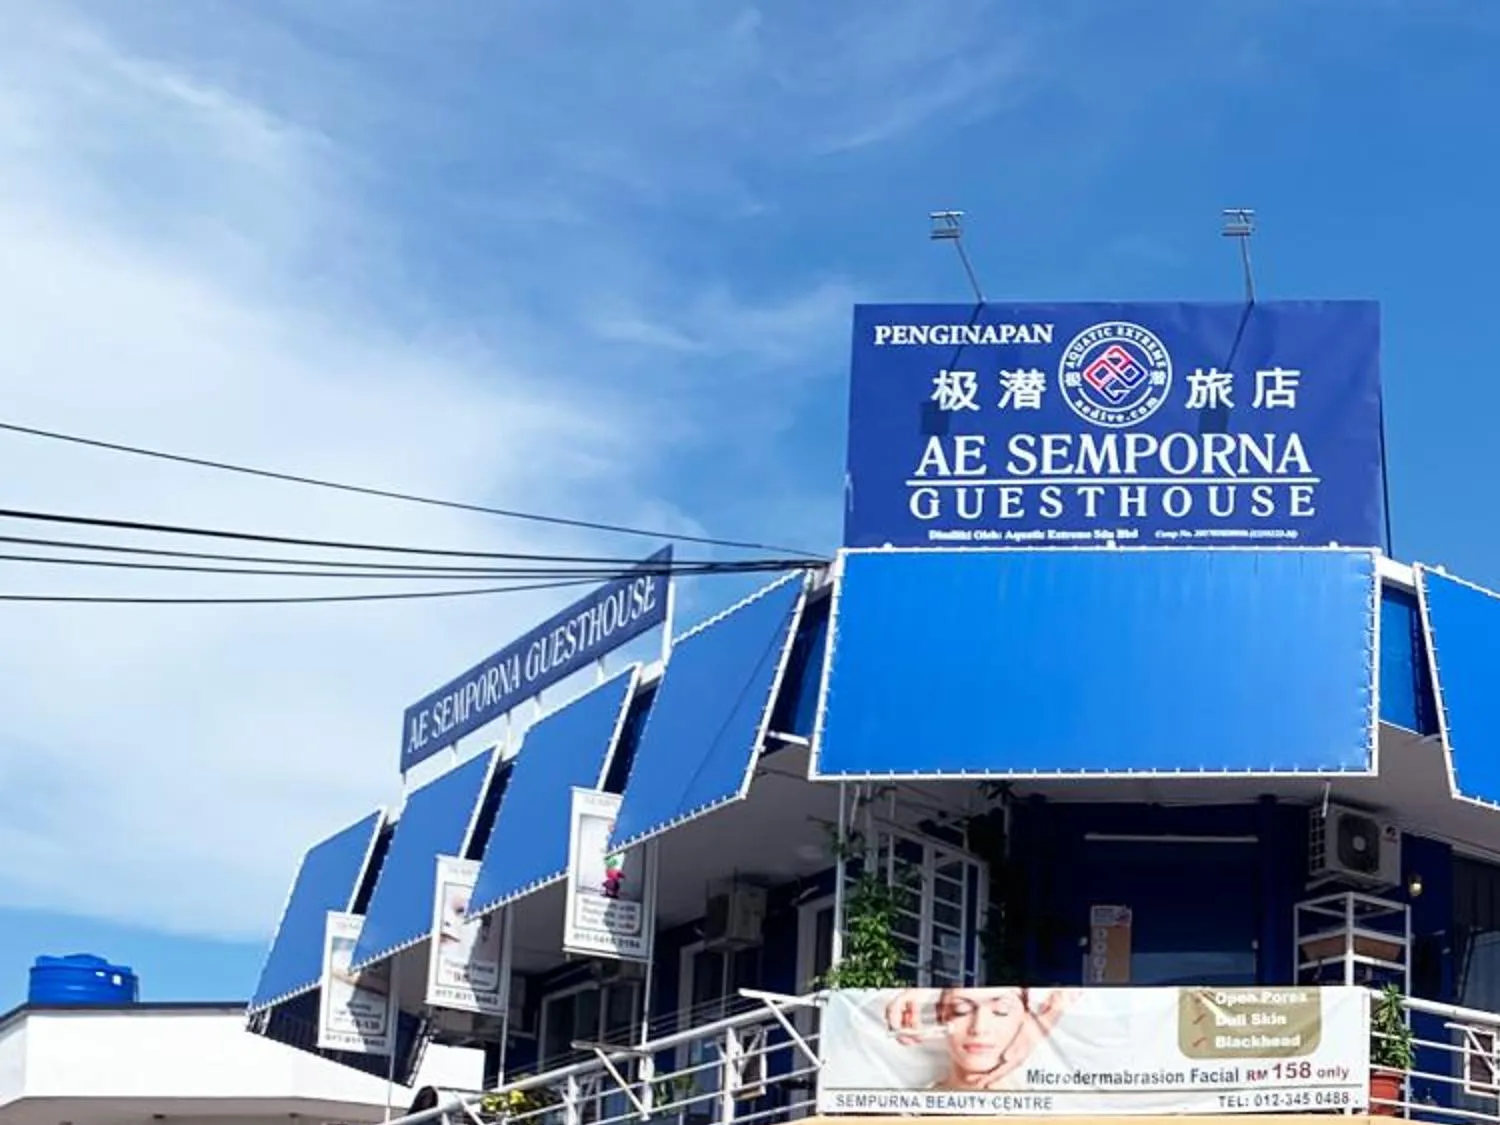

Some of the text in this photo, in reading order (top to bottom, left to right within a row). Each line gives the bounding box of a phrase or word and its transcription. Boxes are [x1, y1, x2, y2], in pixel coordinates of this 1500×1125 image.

[874, 323, 1054, 345] PENGINAPAN
[1065, 326, 1167, 368] AQUATIC EXTREME
[1186, 367, 1300, 410] 旅店
[914, 432, 1313, 478] AE SEMPORNA
[909, 485, 1316, 521] GUESTHOUSE
[407, 576, 656, 753] AE SEMPORNA GUESTHOUSE
[1215, 991, 1258, 1006] Open
[1251, 1012, 1287, 1026] Skin
[1215, 1034, 1301, 1049] Blackhead
[1027, 1061, 1350, 1086] Microdermabrasion Facial RM 158 only
[836, 1094, 1053, 1110] SEMPURNA BEAUTY CENTRE
[1218, 1095, 1249, 1108] TEL:
